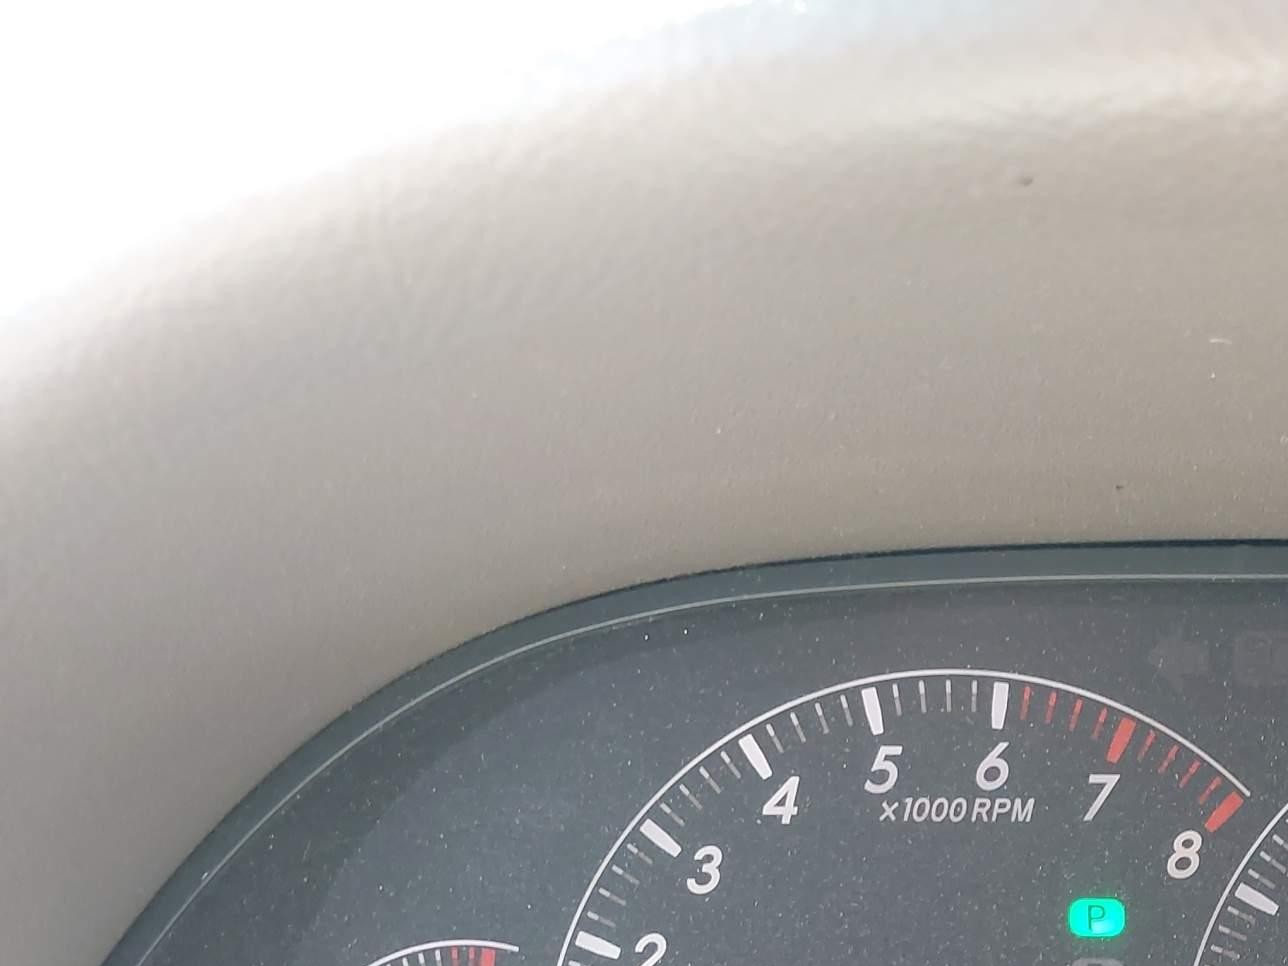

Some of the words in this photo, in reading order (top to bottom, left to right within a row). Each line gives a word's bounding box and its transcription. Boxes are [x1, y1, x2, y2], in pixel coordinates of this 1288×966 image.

[864, 745, 902, 794] 5
[975, 742, 1010, 791] 6
[763, 776, 799, 824] 4
[971, 798, 1035, 823] RPM
[1083, 774, 1120, 822] 7
[686, 845, 723, 895] 3
[1167, 830, 1202, 879] 8
[1088, 905, 1106, 930] P
